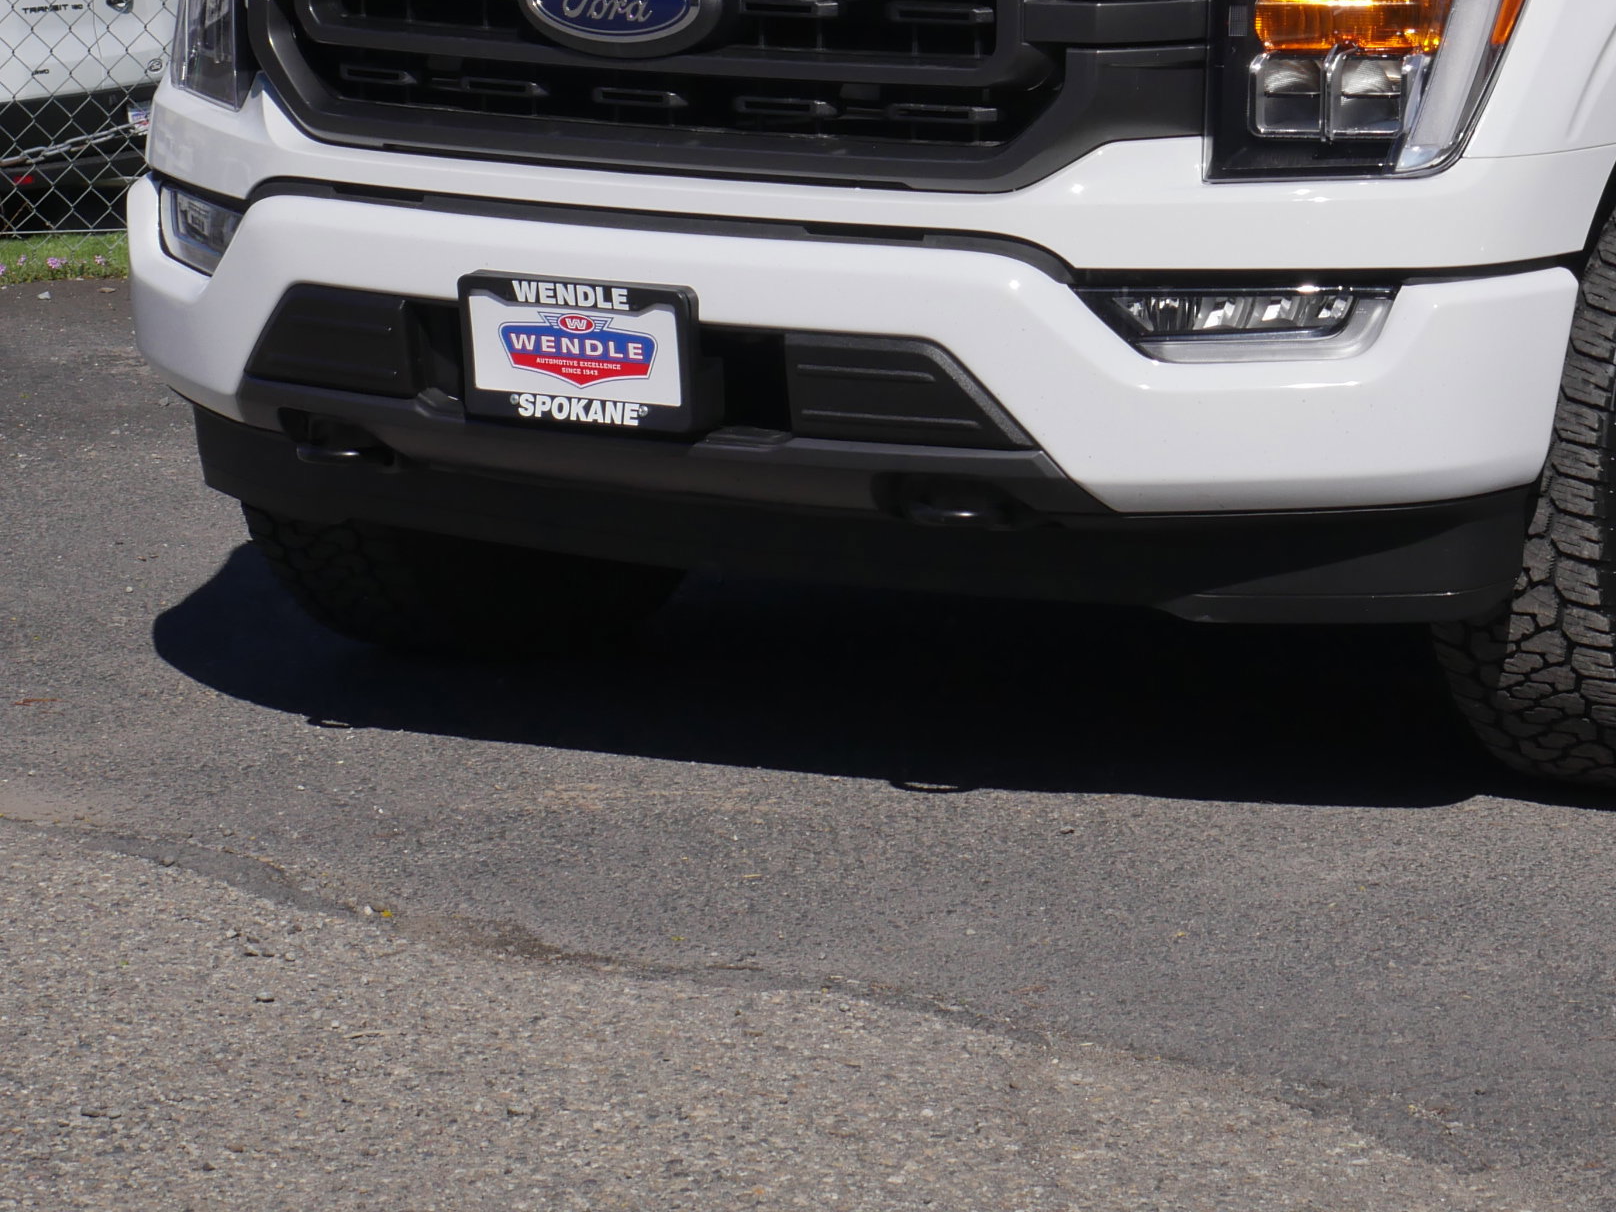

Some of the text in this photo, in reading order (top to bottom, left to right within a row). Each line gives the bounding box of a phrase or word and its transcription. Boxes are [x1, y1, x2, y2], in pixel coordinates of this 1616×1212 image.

[512, 280, 630, 310] WENDLE
[510, 333, 644, 360] WENDLE
[536, 357, 622, 371] AUTOMOTIVE EXCELLENCE
[561, 367, 582, 376] SINCE
[518, 393, 640, 426] SPOKANE
